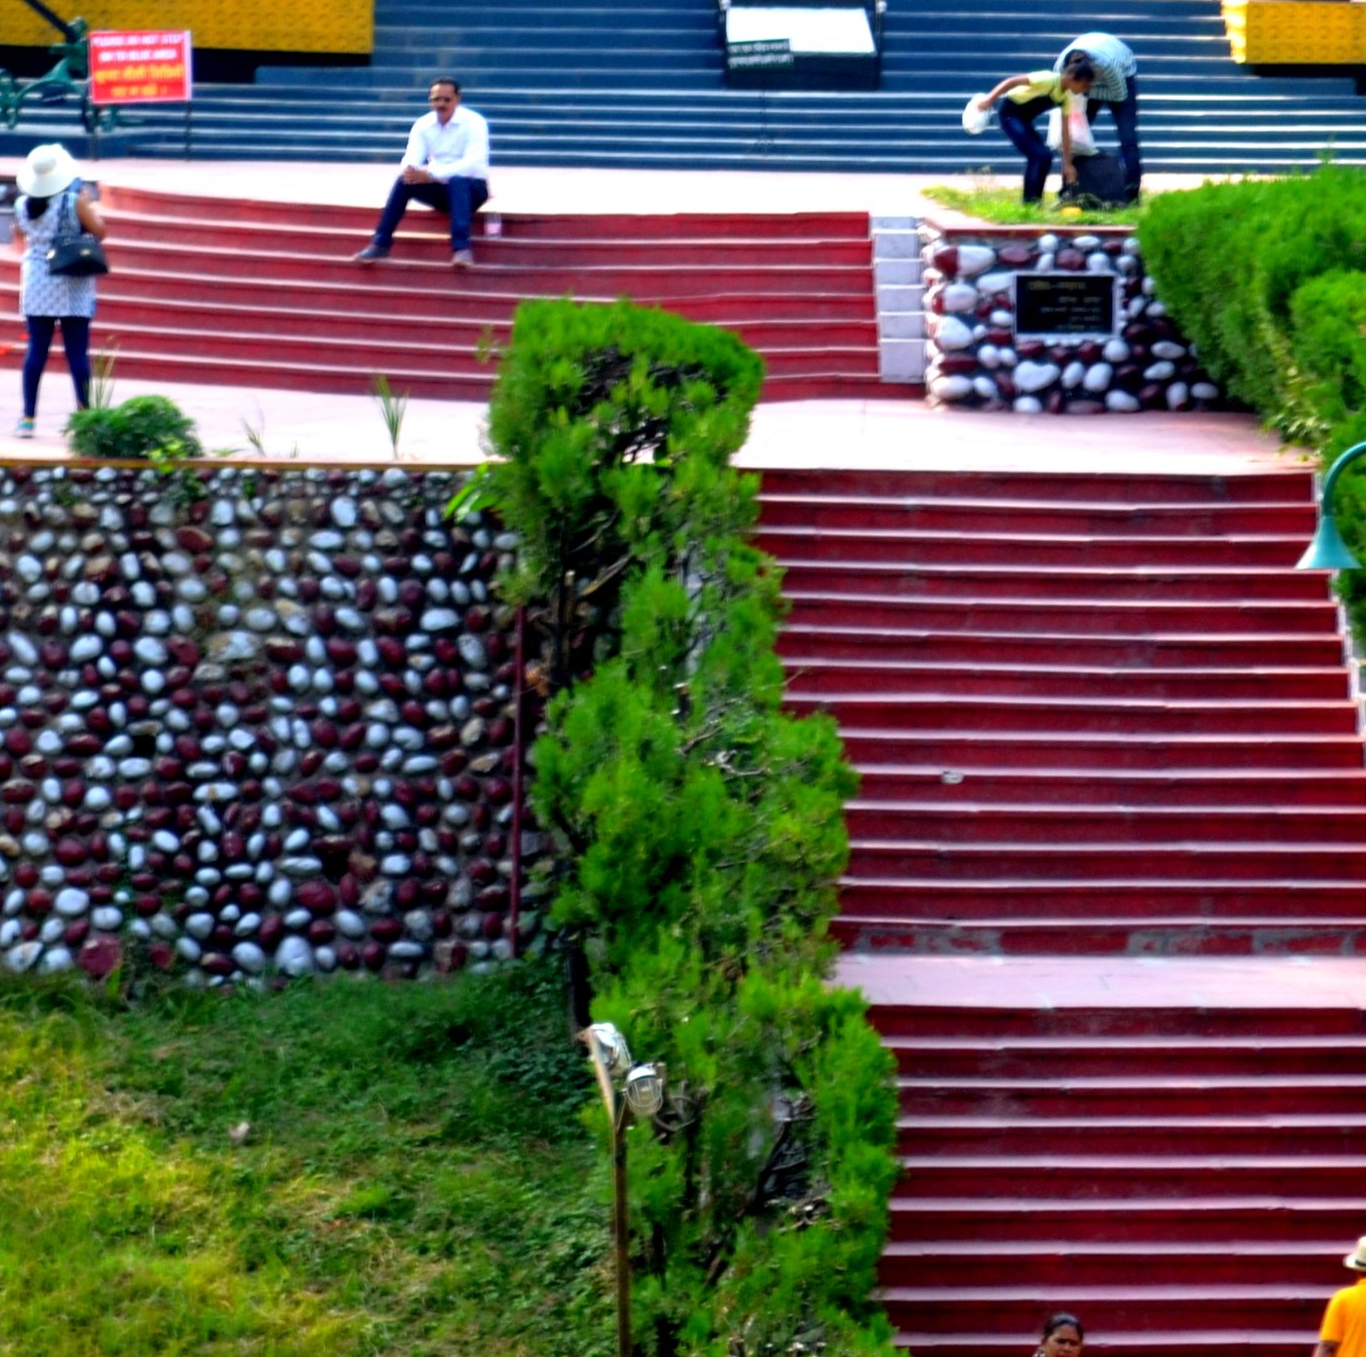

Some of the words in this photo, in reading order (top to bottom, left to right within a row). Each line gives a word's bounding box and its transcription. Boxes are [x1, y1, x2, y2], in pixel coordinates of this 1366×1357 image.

[91, 35, 124, 47] PLEASE
[127, 35, 138, 46] DO
[141, 35, 158, 45] NOT
[161, 33, 183, 44] STEP
